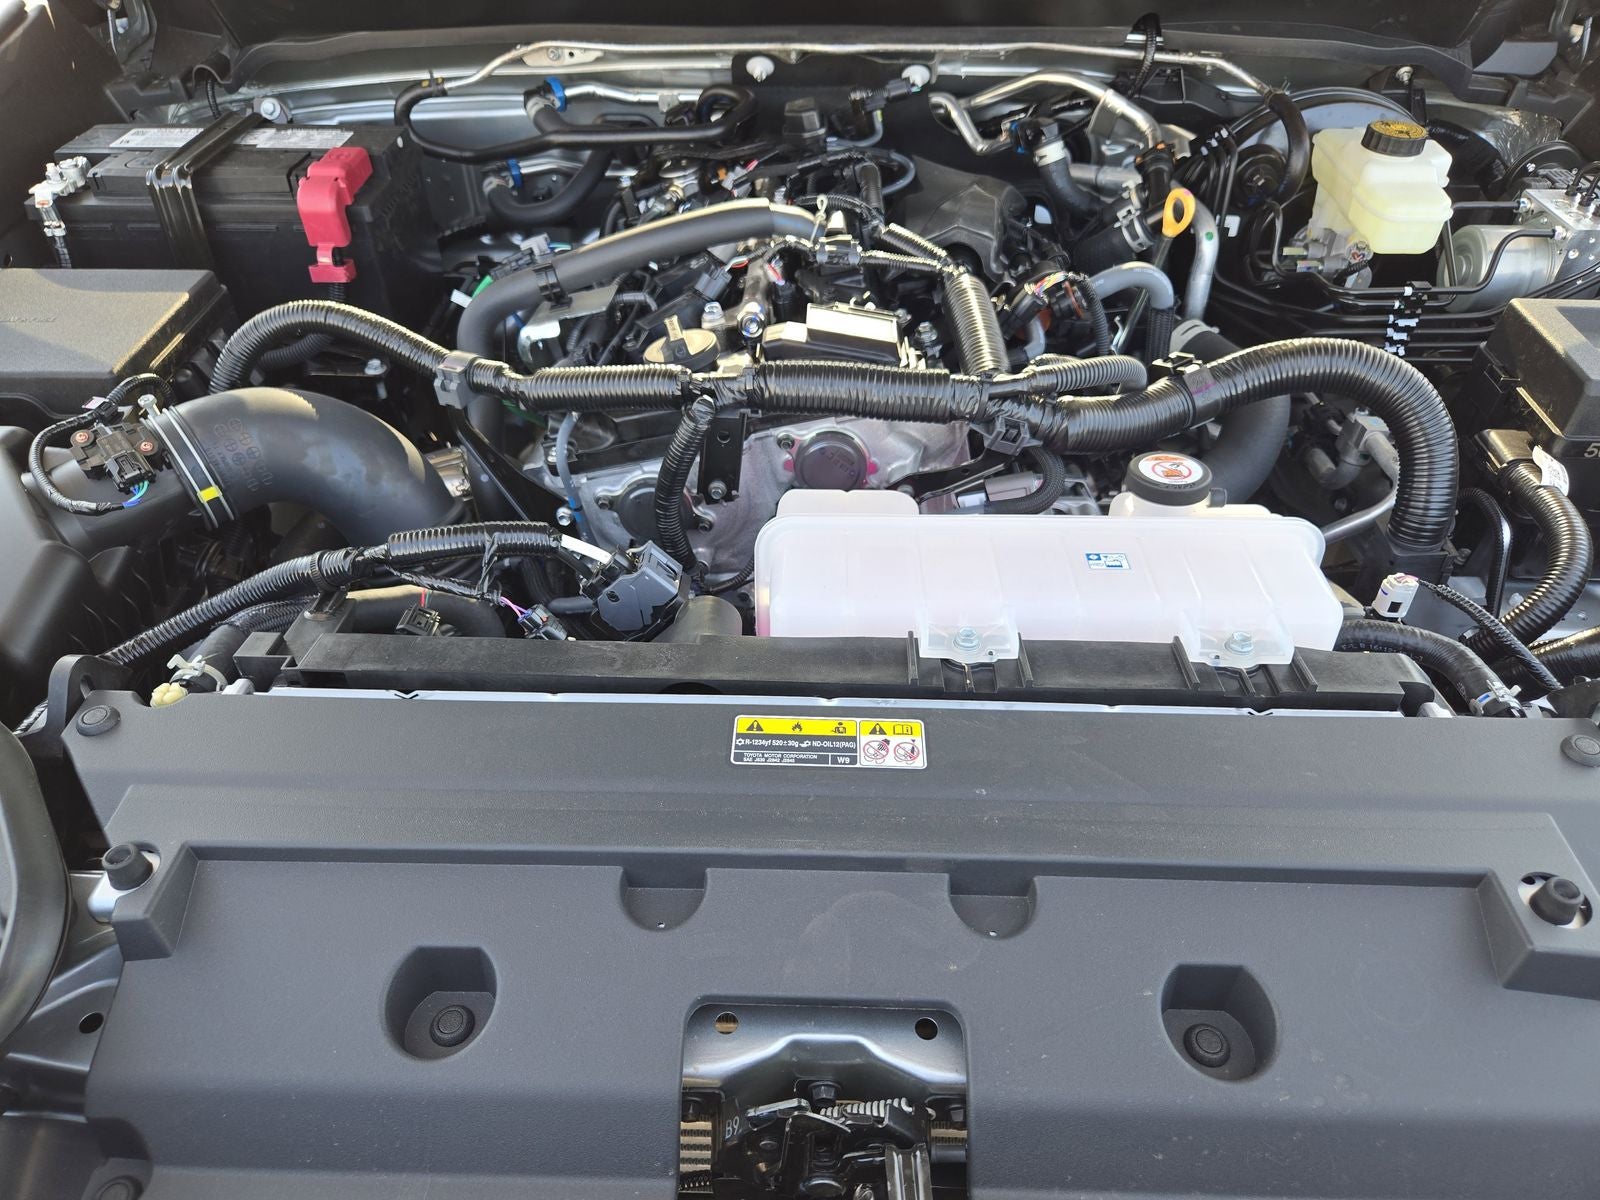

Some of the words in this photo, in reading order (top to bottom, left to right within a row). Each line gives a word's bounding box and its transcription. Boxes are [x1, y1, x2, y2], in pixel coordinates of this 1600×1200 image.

[1584, 442, 1600, 458] 5
[745, 739, 771, 747] R-1234yf
[725, 1116, 739, 1139] B9
